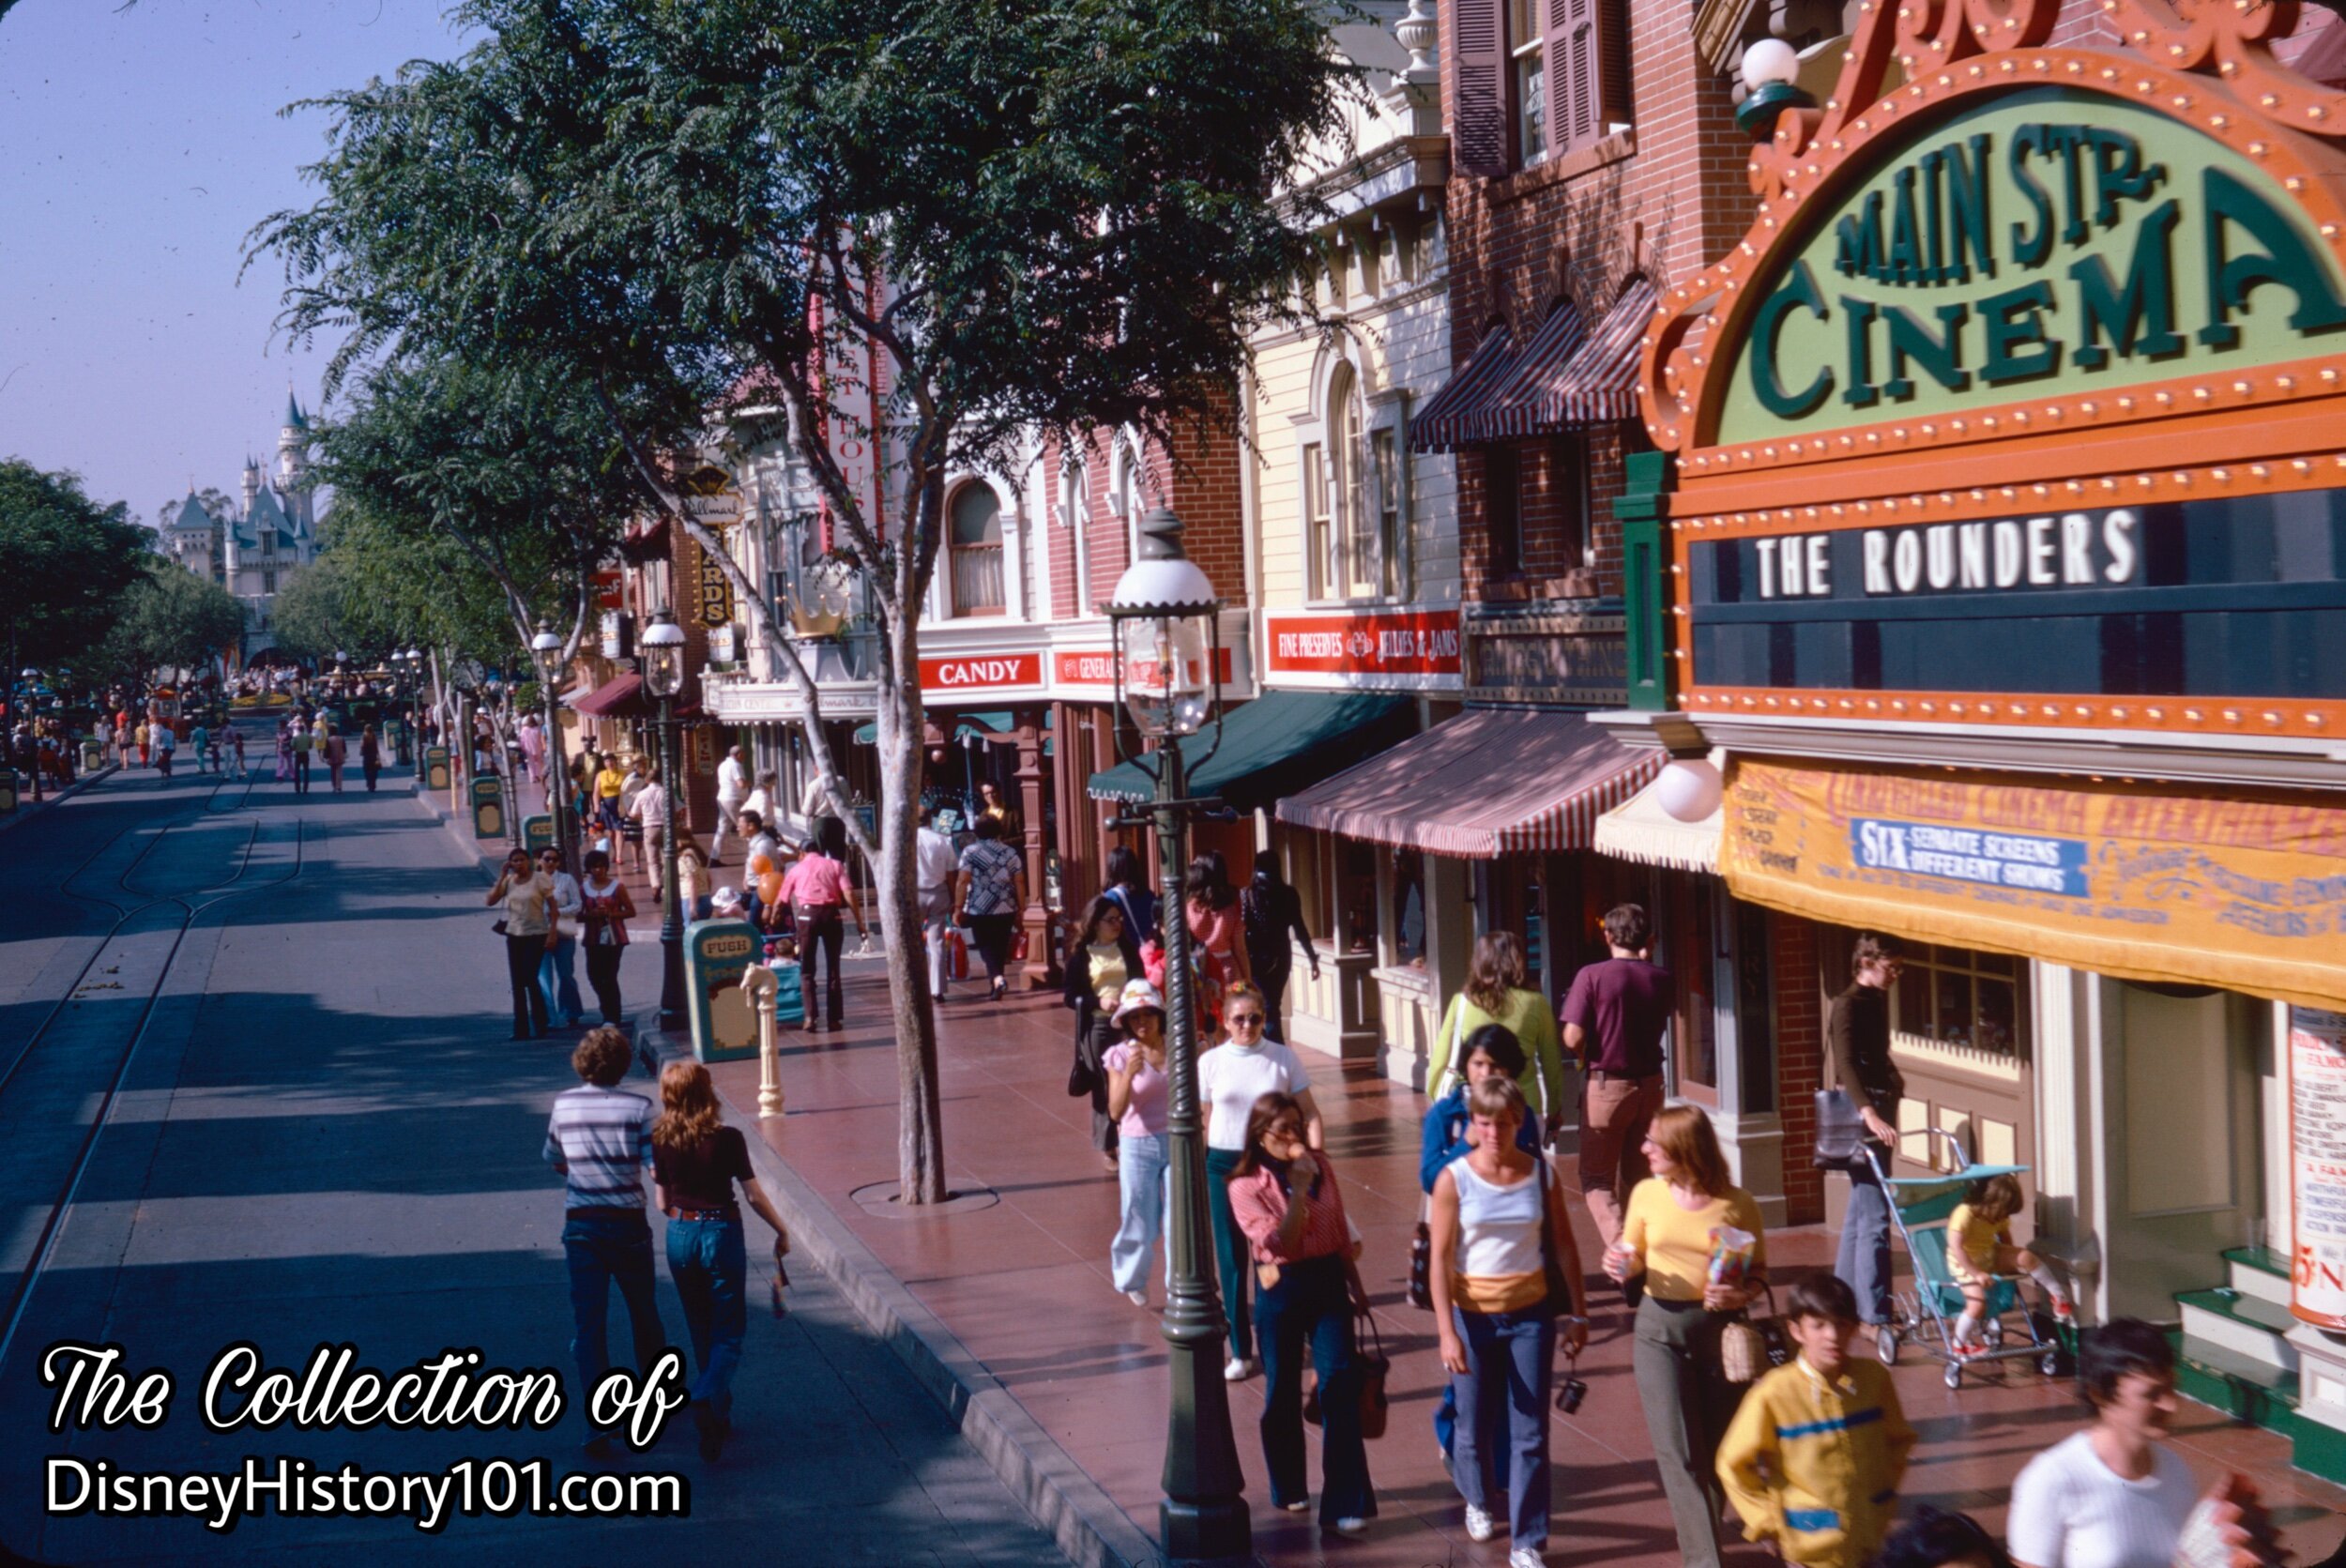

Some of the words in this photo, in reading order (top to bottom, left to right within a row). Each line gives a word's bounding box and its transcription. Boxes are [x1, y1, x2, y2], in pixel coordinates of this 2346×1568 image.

[1836, 132, 1994, 288] MAIN
[1749, 165, 2346, 419] CINEMA
[687, 498, 739, 516] allmark
[1756, 535, 1831, 600] THE
[1864, 510, 2137, 594] ROUNDERS
[1278, 632, 1298, 658] FINE
[1299, 632, 1343, 658] PRESERVES
[1417, 631, 1426, 657] &
[1428, 629, 1458, 662] JAMS
[938, 660, 1022, 685] CANDY
[1860, 819, 1911, 870] SIX
[1983, 834, 2061, 867] SCREENS
[1910, 849, 2001, 883] DIFFERENT
[2002, 861, 2064, 892] SHOWS
[707, 940, 748, 954] PUSH
